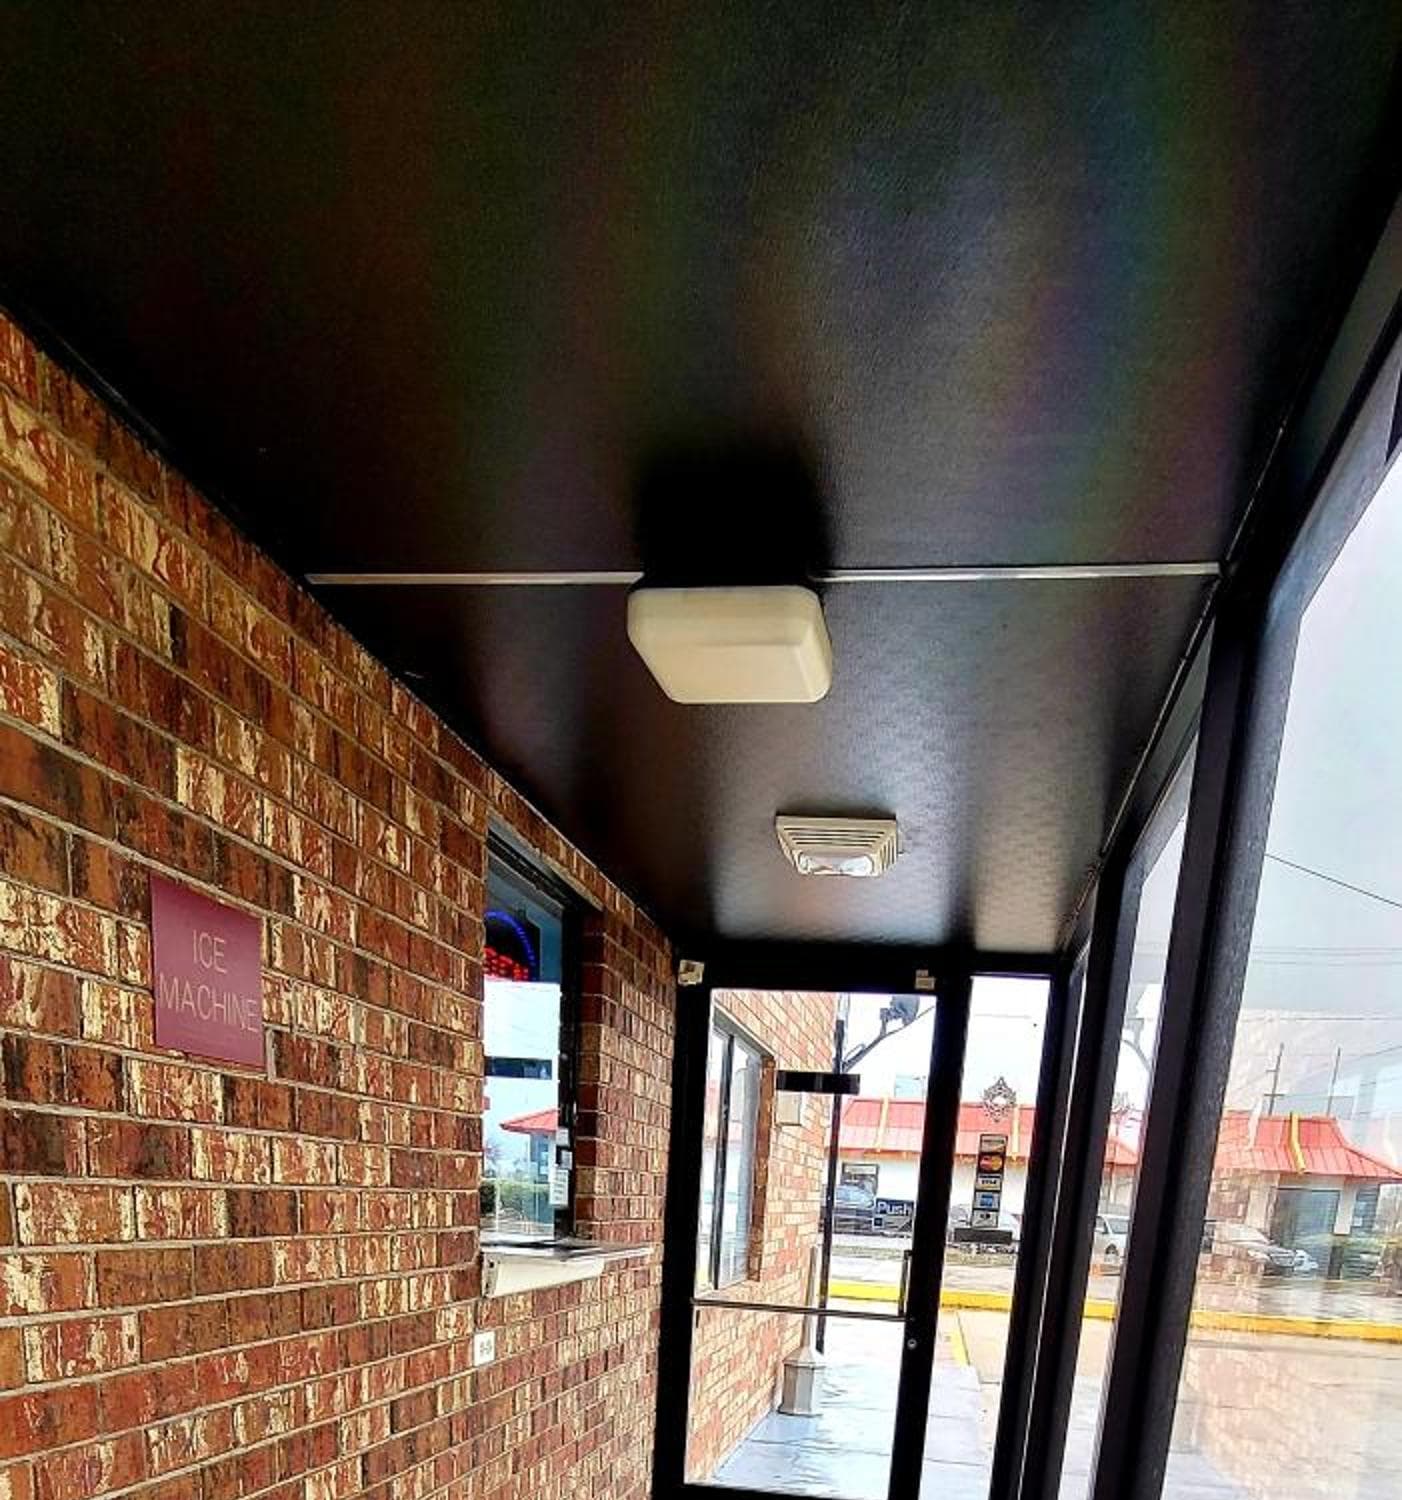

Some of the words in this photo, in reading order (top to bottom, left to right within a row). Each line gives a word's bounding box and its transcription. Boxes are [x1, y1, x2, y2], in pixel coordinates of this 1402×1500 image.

[192, 929, 228, 974] ICE
[158, 971, 260, 1033] MACHINE
[877, 1201, 912, 1216] Push
